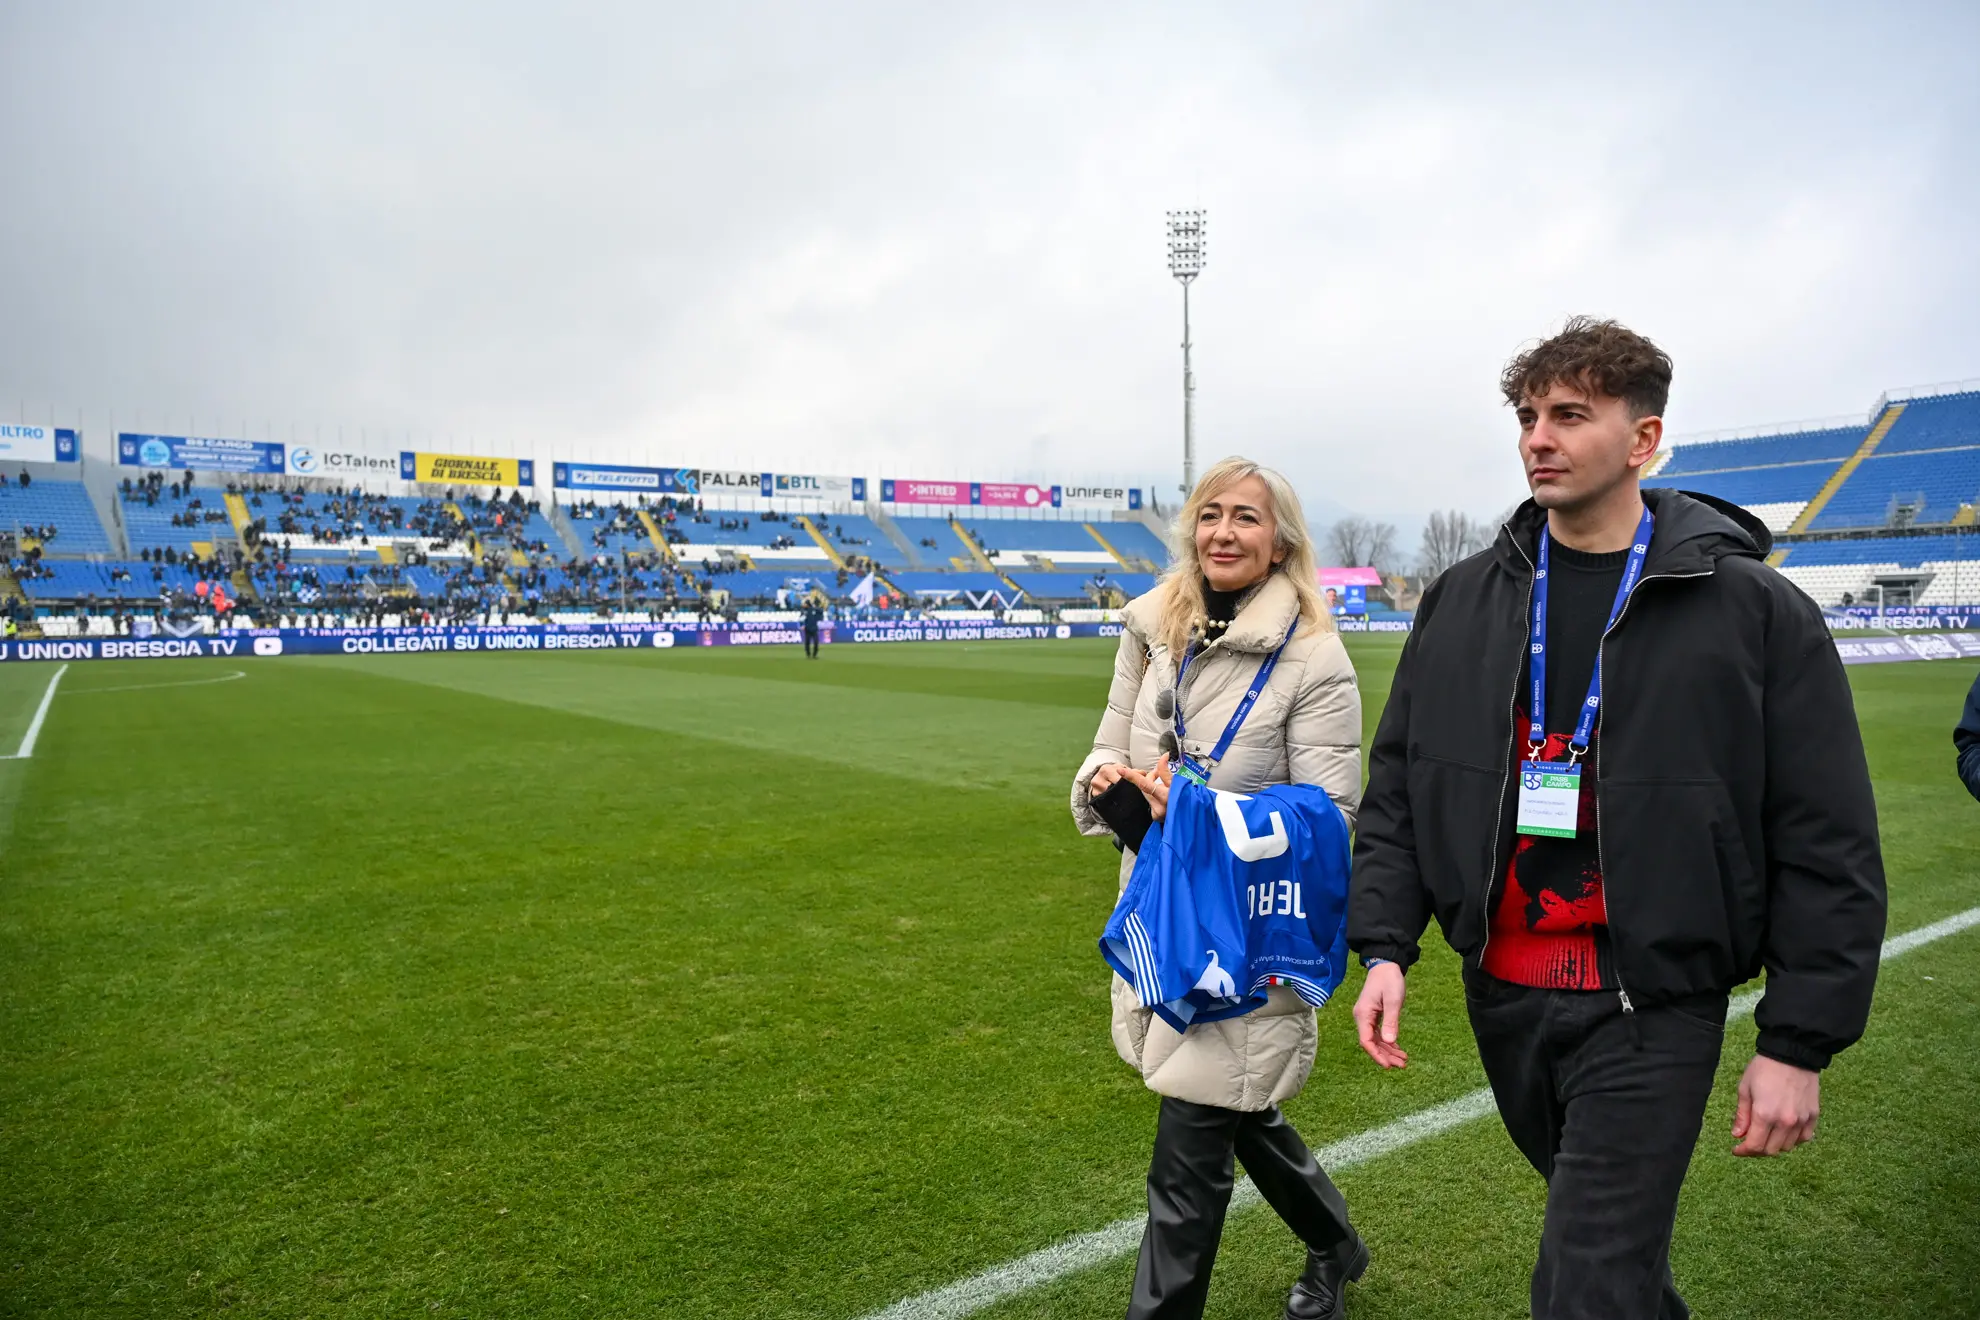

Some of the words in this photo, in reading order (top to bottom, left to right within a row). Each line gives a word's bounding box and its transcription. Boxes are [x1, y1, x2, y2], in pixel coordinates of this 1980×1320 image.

[0, 425, 44, 439] ILTRO
[324, 453, 396, 469] ICTalent
[434, 458, 499, 471] GIORNALE
[431, 468, 444, 478] DI
[448, 470, 502, 481] BRESCIA
[703, 473, 760, 487] FALAR
[791, 476, 820, 489] BTL
[916, 485, 957, 497] INTRED
[1065, 487, 1124, 499] UNIFER
[1870, 616, 1942, 629] BRESCIA
[1946, 616, 1969, 629] TV
[730, 631, 761, 644] UNION
[761, 630, 801, 643] BRESCIA
[854, 628, 922, 642] COLLEGATI
[925, 628, 942, 640] SU
[945, 627, 981, 640] UNION
[984, 626, 1032, 639] BRESCIA
[1034, 626, 1050, 638] TV
[1099, 625, 1123, 637] COLL
[343, 635, 448, 653] COLLEGATI
[454, 634, 479, 650] SU
[485, 633, 539, 649] UNION
[544, 633, 617, 648] BRESCIA
[621, 632, 642, 647] TV
[18, 642, 93, 660] UNION
[101, 639, 203, 658] BRESCIA
[208, 639, 237, 656] TV
